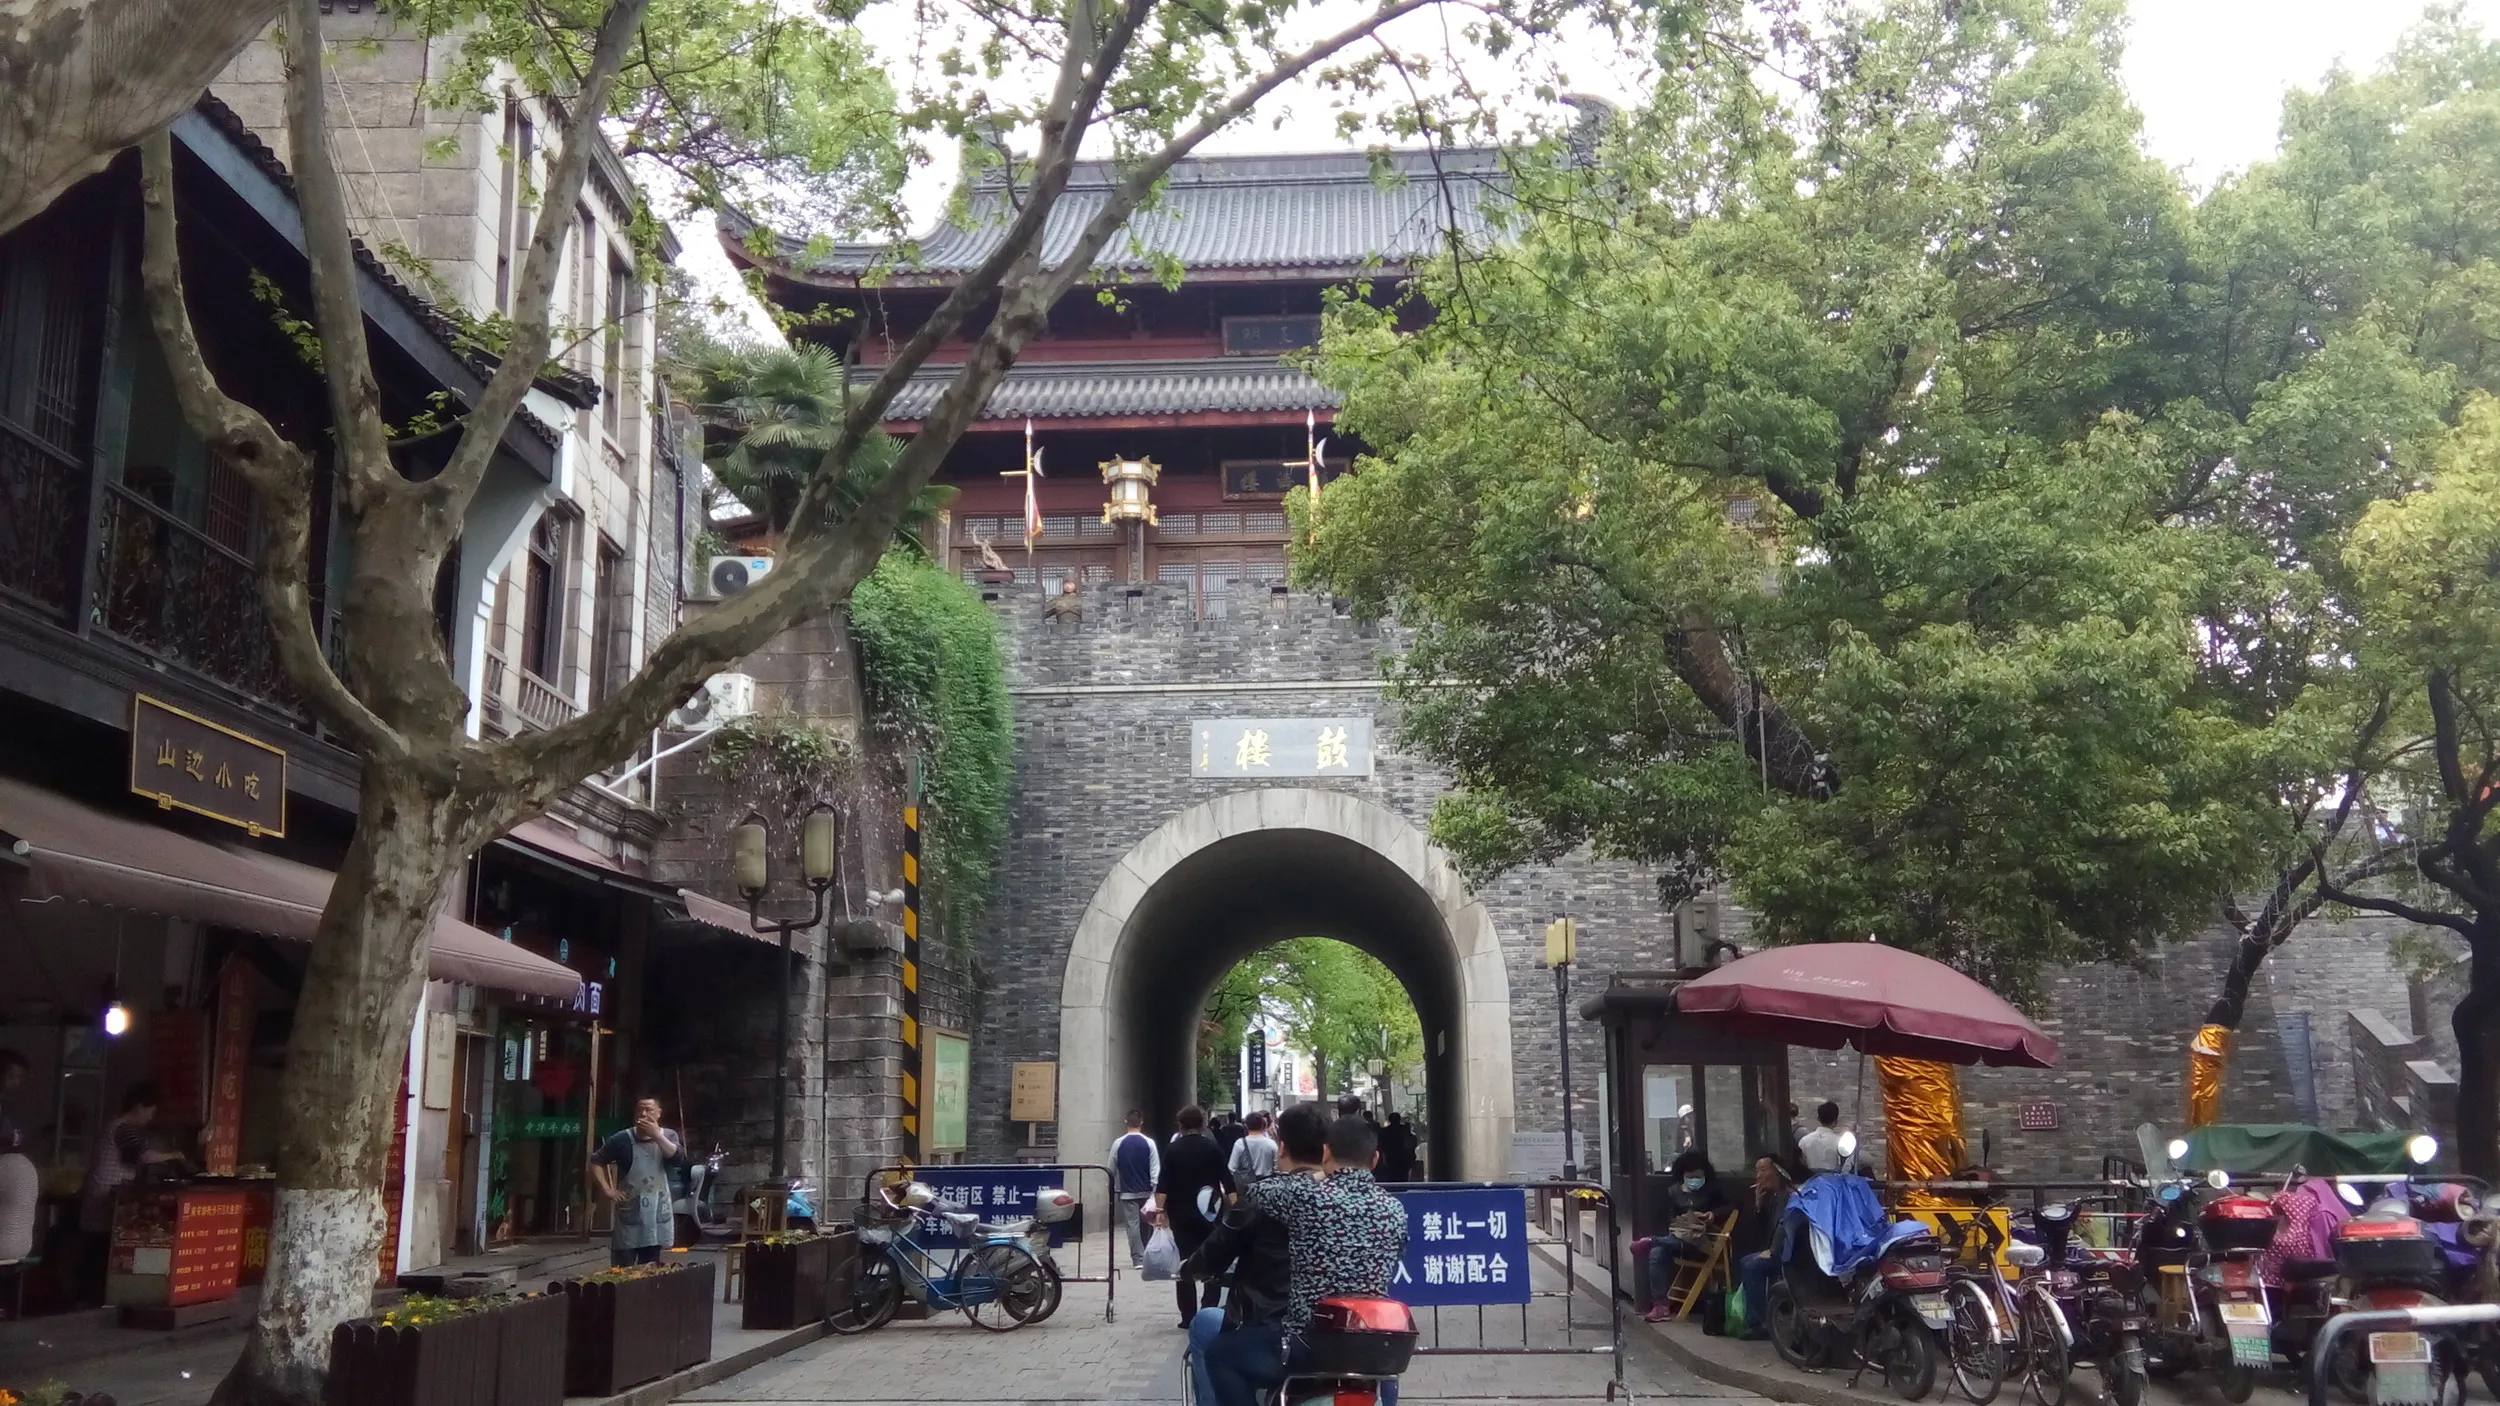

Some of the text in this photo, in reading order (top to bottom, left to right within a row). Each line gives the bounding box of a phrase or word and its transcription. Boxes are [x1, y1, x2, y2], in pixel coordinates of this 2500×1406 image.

[157, 738, 260, 801] 山边小吃
[1422, 1210, 1508, 1242] 禁止一切
[1423, 1252, 1509, 1285] 谢谢配合
